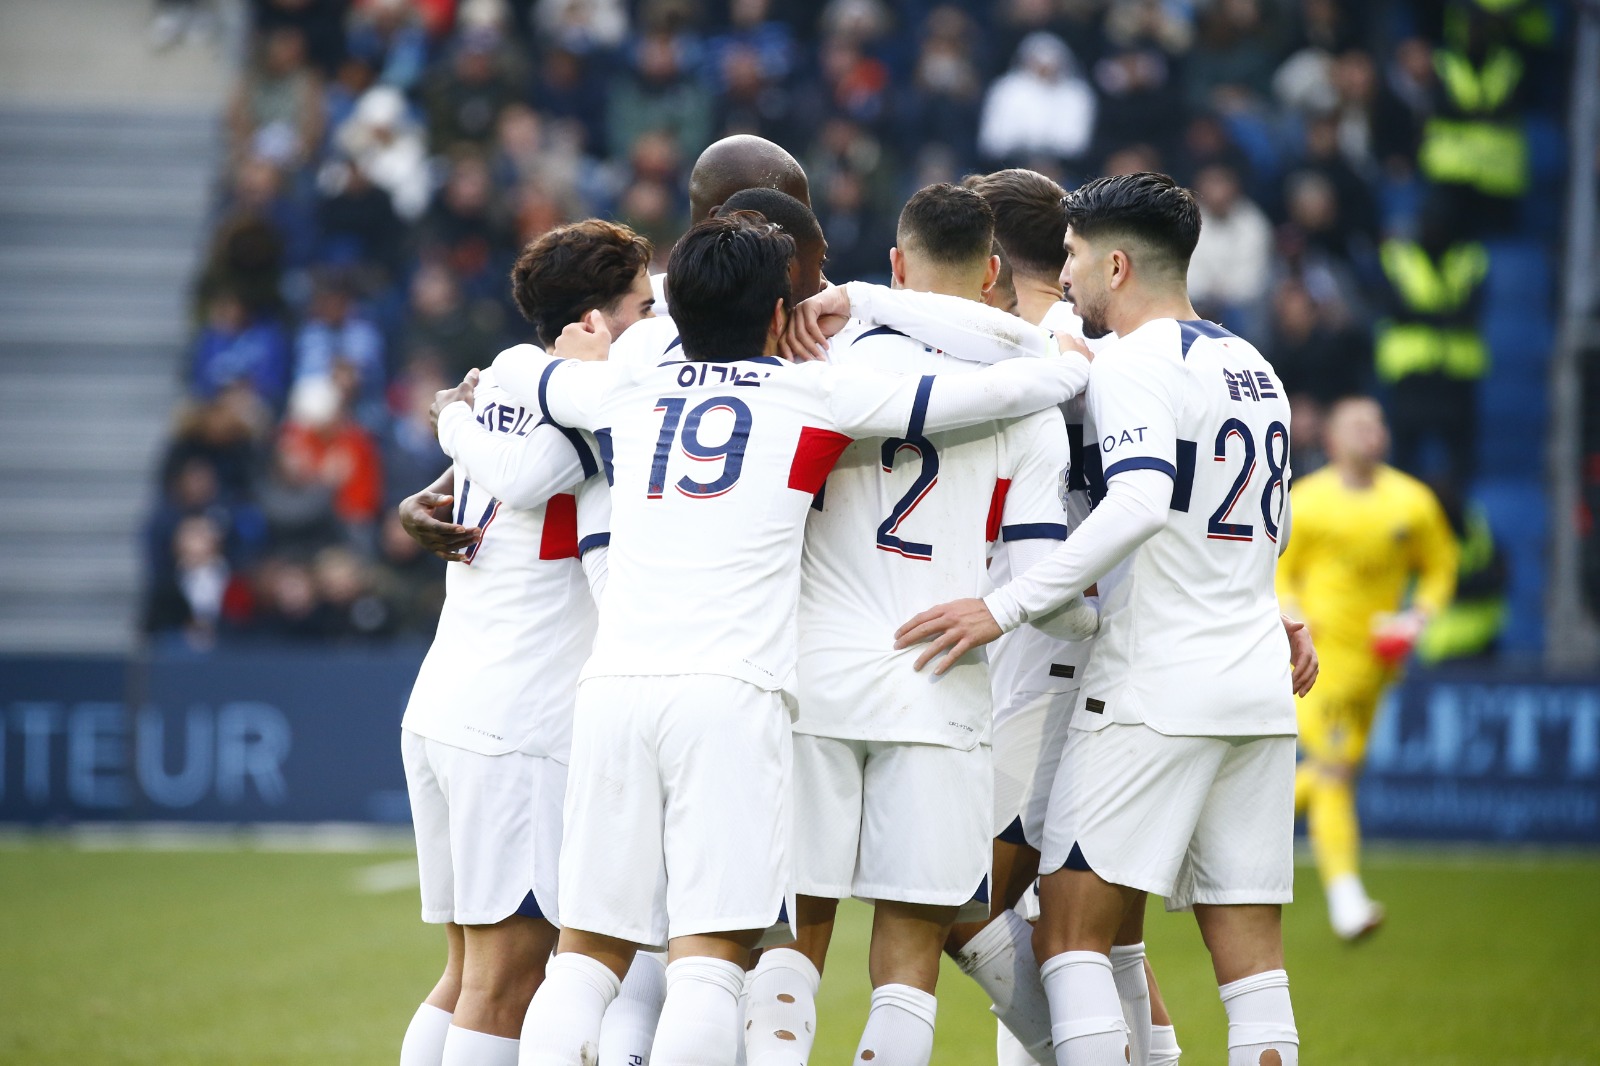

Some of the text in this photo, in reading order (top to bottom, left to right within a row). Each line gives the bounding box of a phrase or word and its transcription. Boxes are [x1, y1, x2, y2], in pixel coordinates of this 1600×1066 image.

[647, 396, 752, 500] 19
[876, 436, 940, 562] 2
[1207, 417, 1289, 544] 28
[0, 700, 293, 807] TEUR
